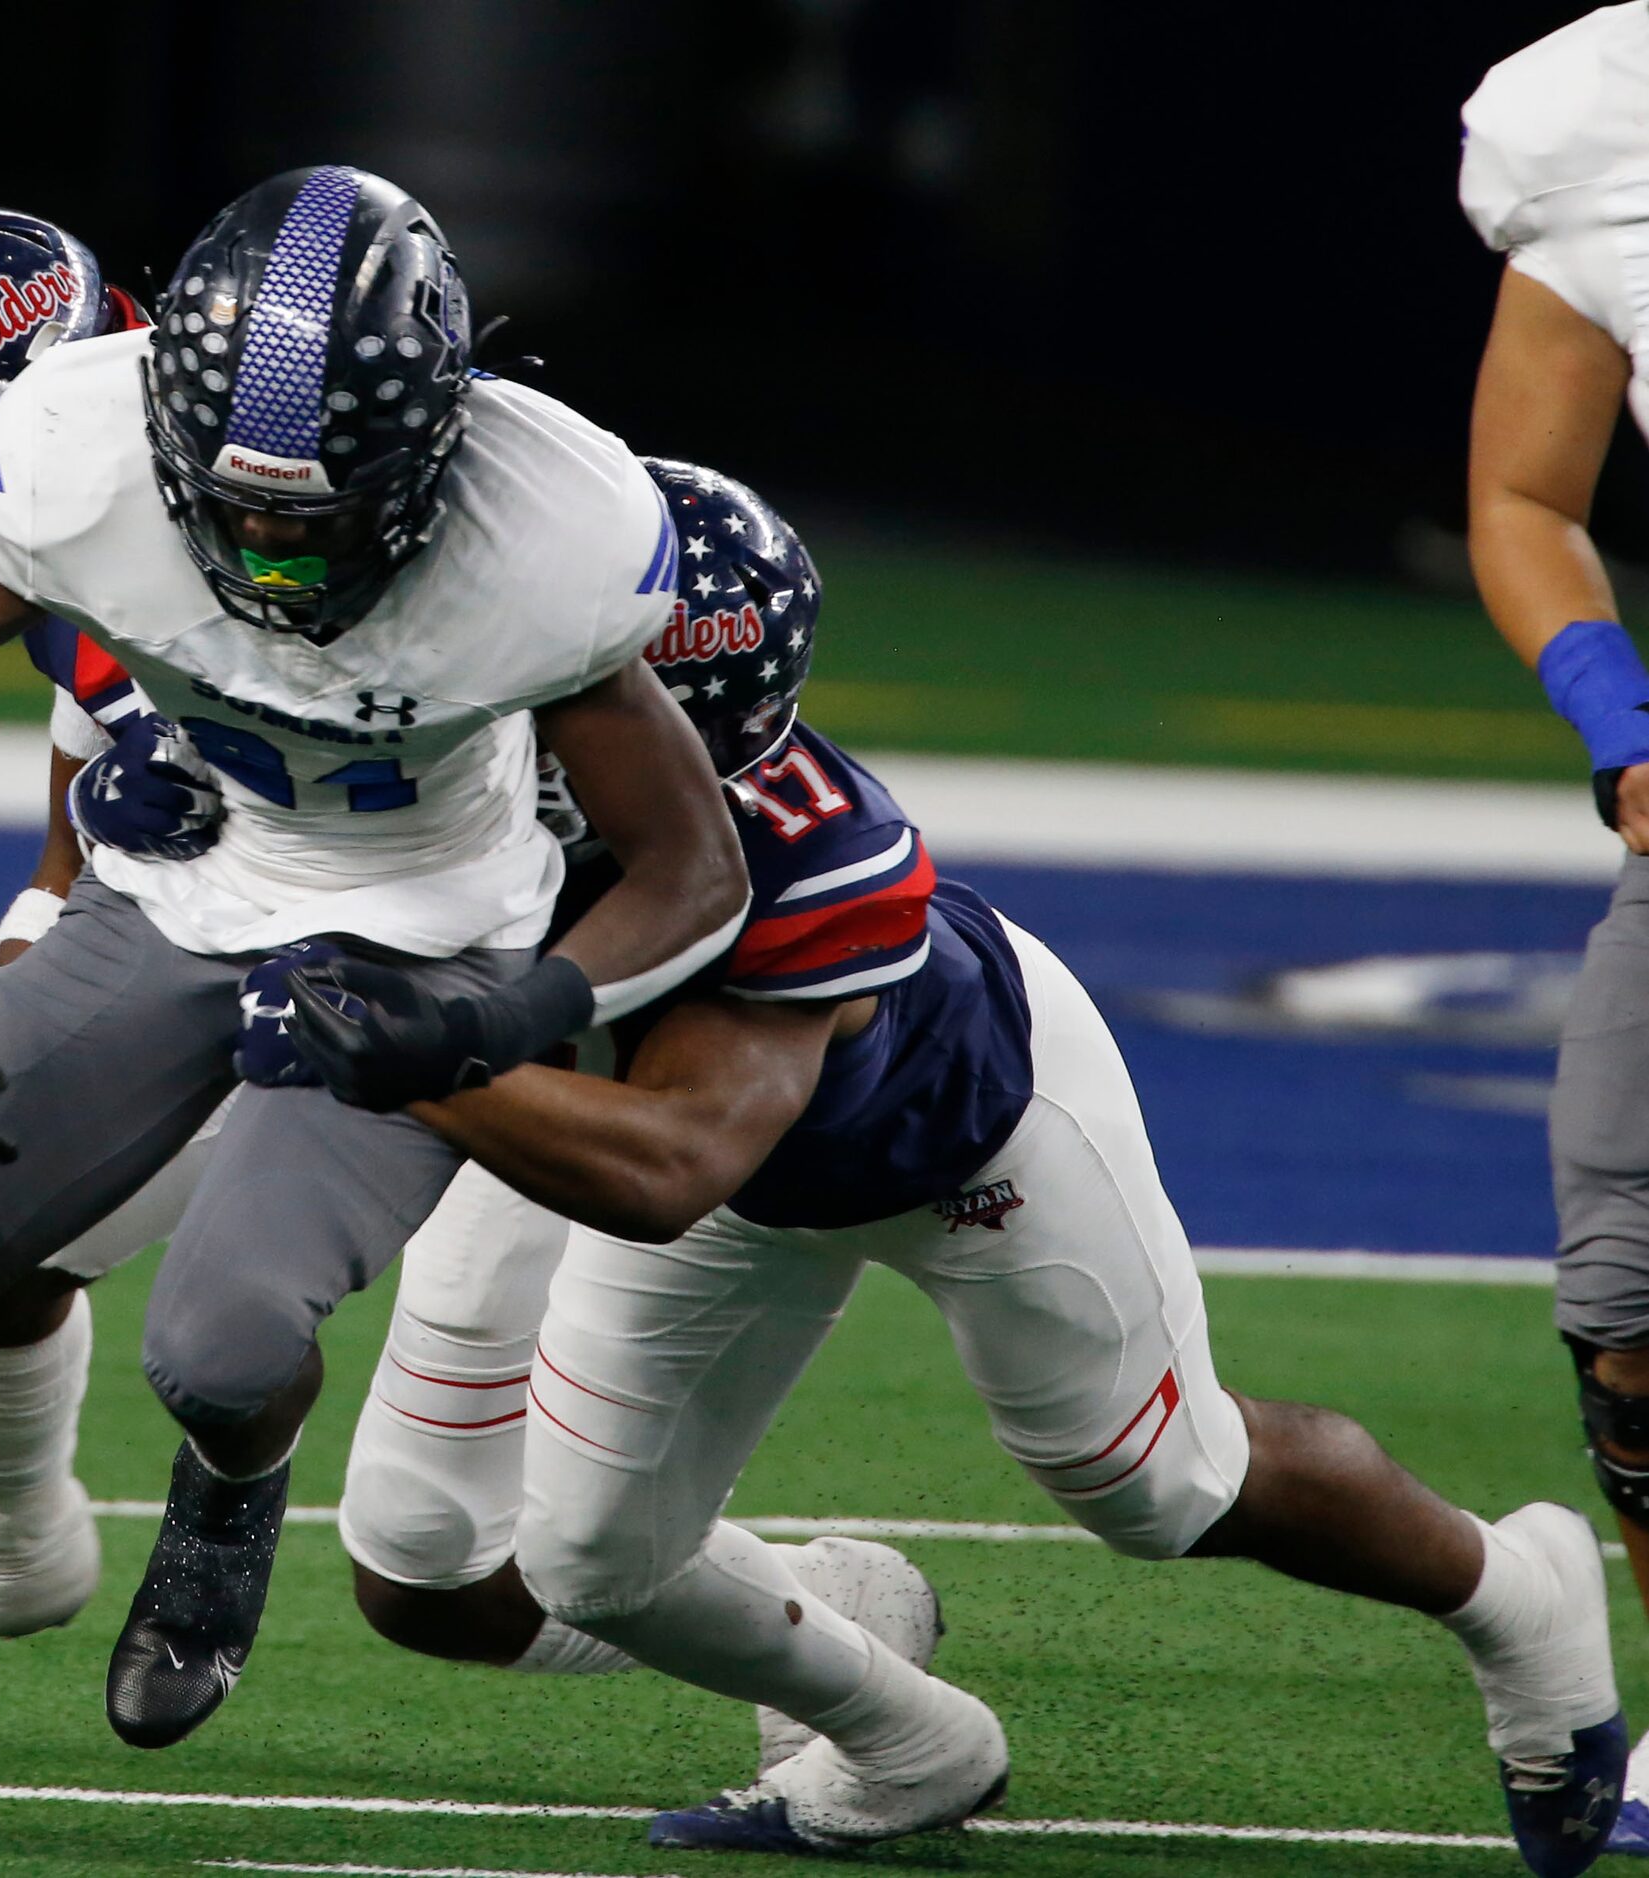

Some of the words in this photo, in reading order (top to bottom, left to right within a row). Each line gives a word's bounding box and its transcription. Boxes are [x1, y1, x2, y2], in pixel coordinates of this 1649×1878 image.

[229, 455, 313, 481] Riddell
[737, 745, 853, 844] 17
[940, 1181, 1014, 1216] RYAN
